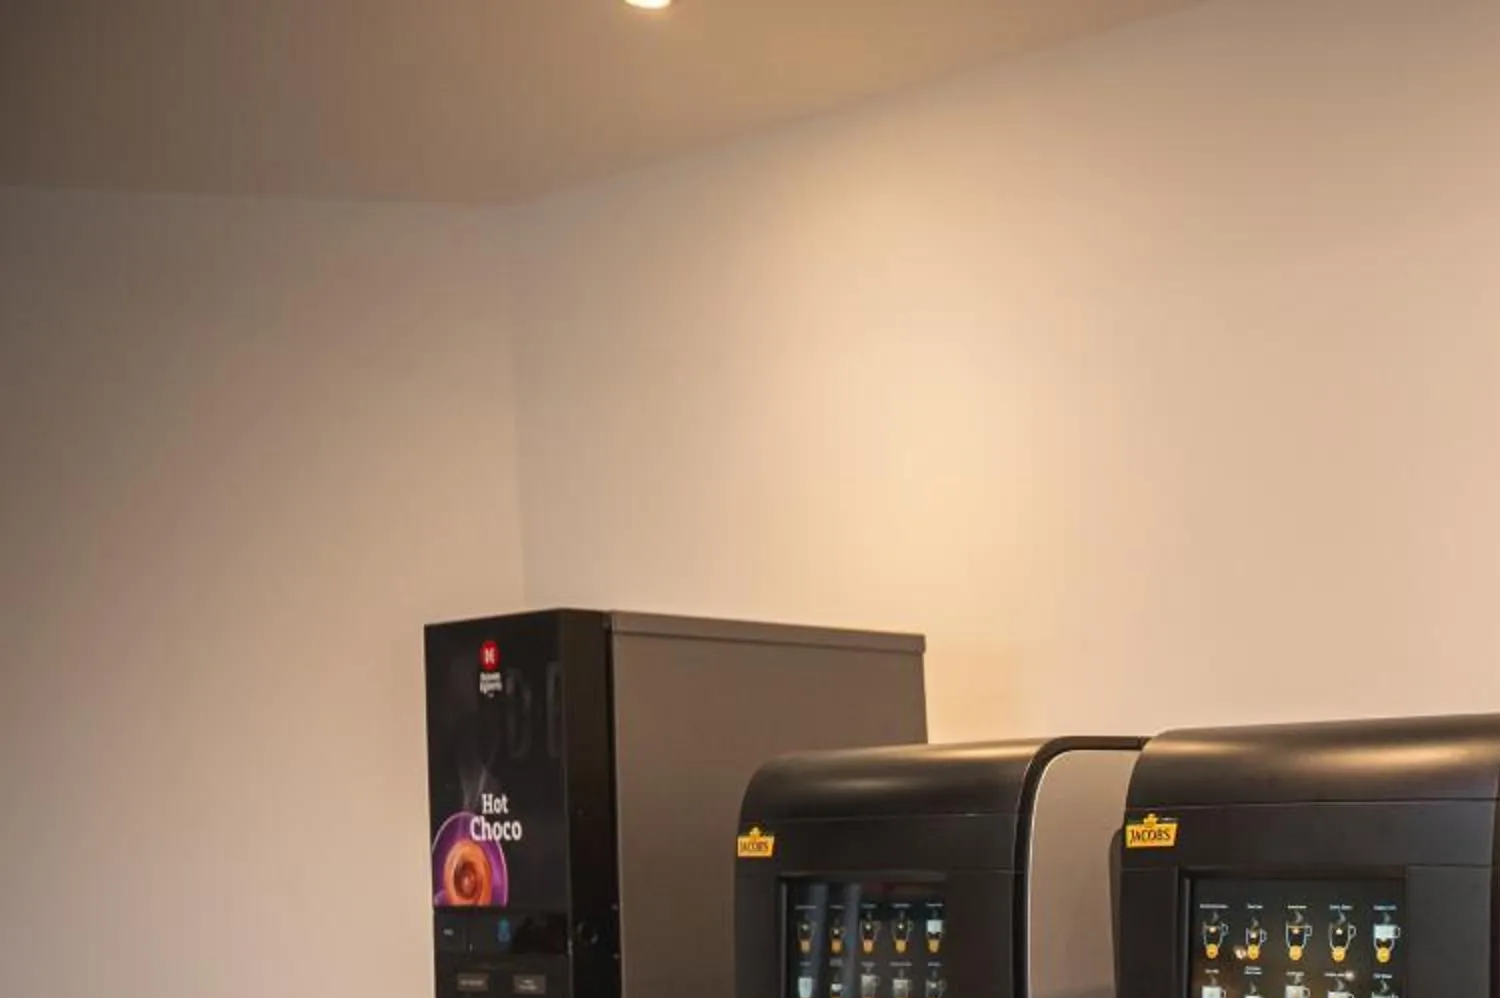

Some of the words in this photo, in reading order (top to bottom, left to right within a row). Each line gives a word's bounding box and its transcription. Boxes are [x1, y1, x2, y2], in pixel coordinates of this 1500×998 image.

[481, 793, 509, 815] Hot
[470, 815, 523, 841] Choco
[1129, 827, 1171, 845] JACOBS
